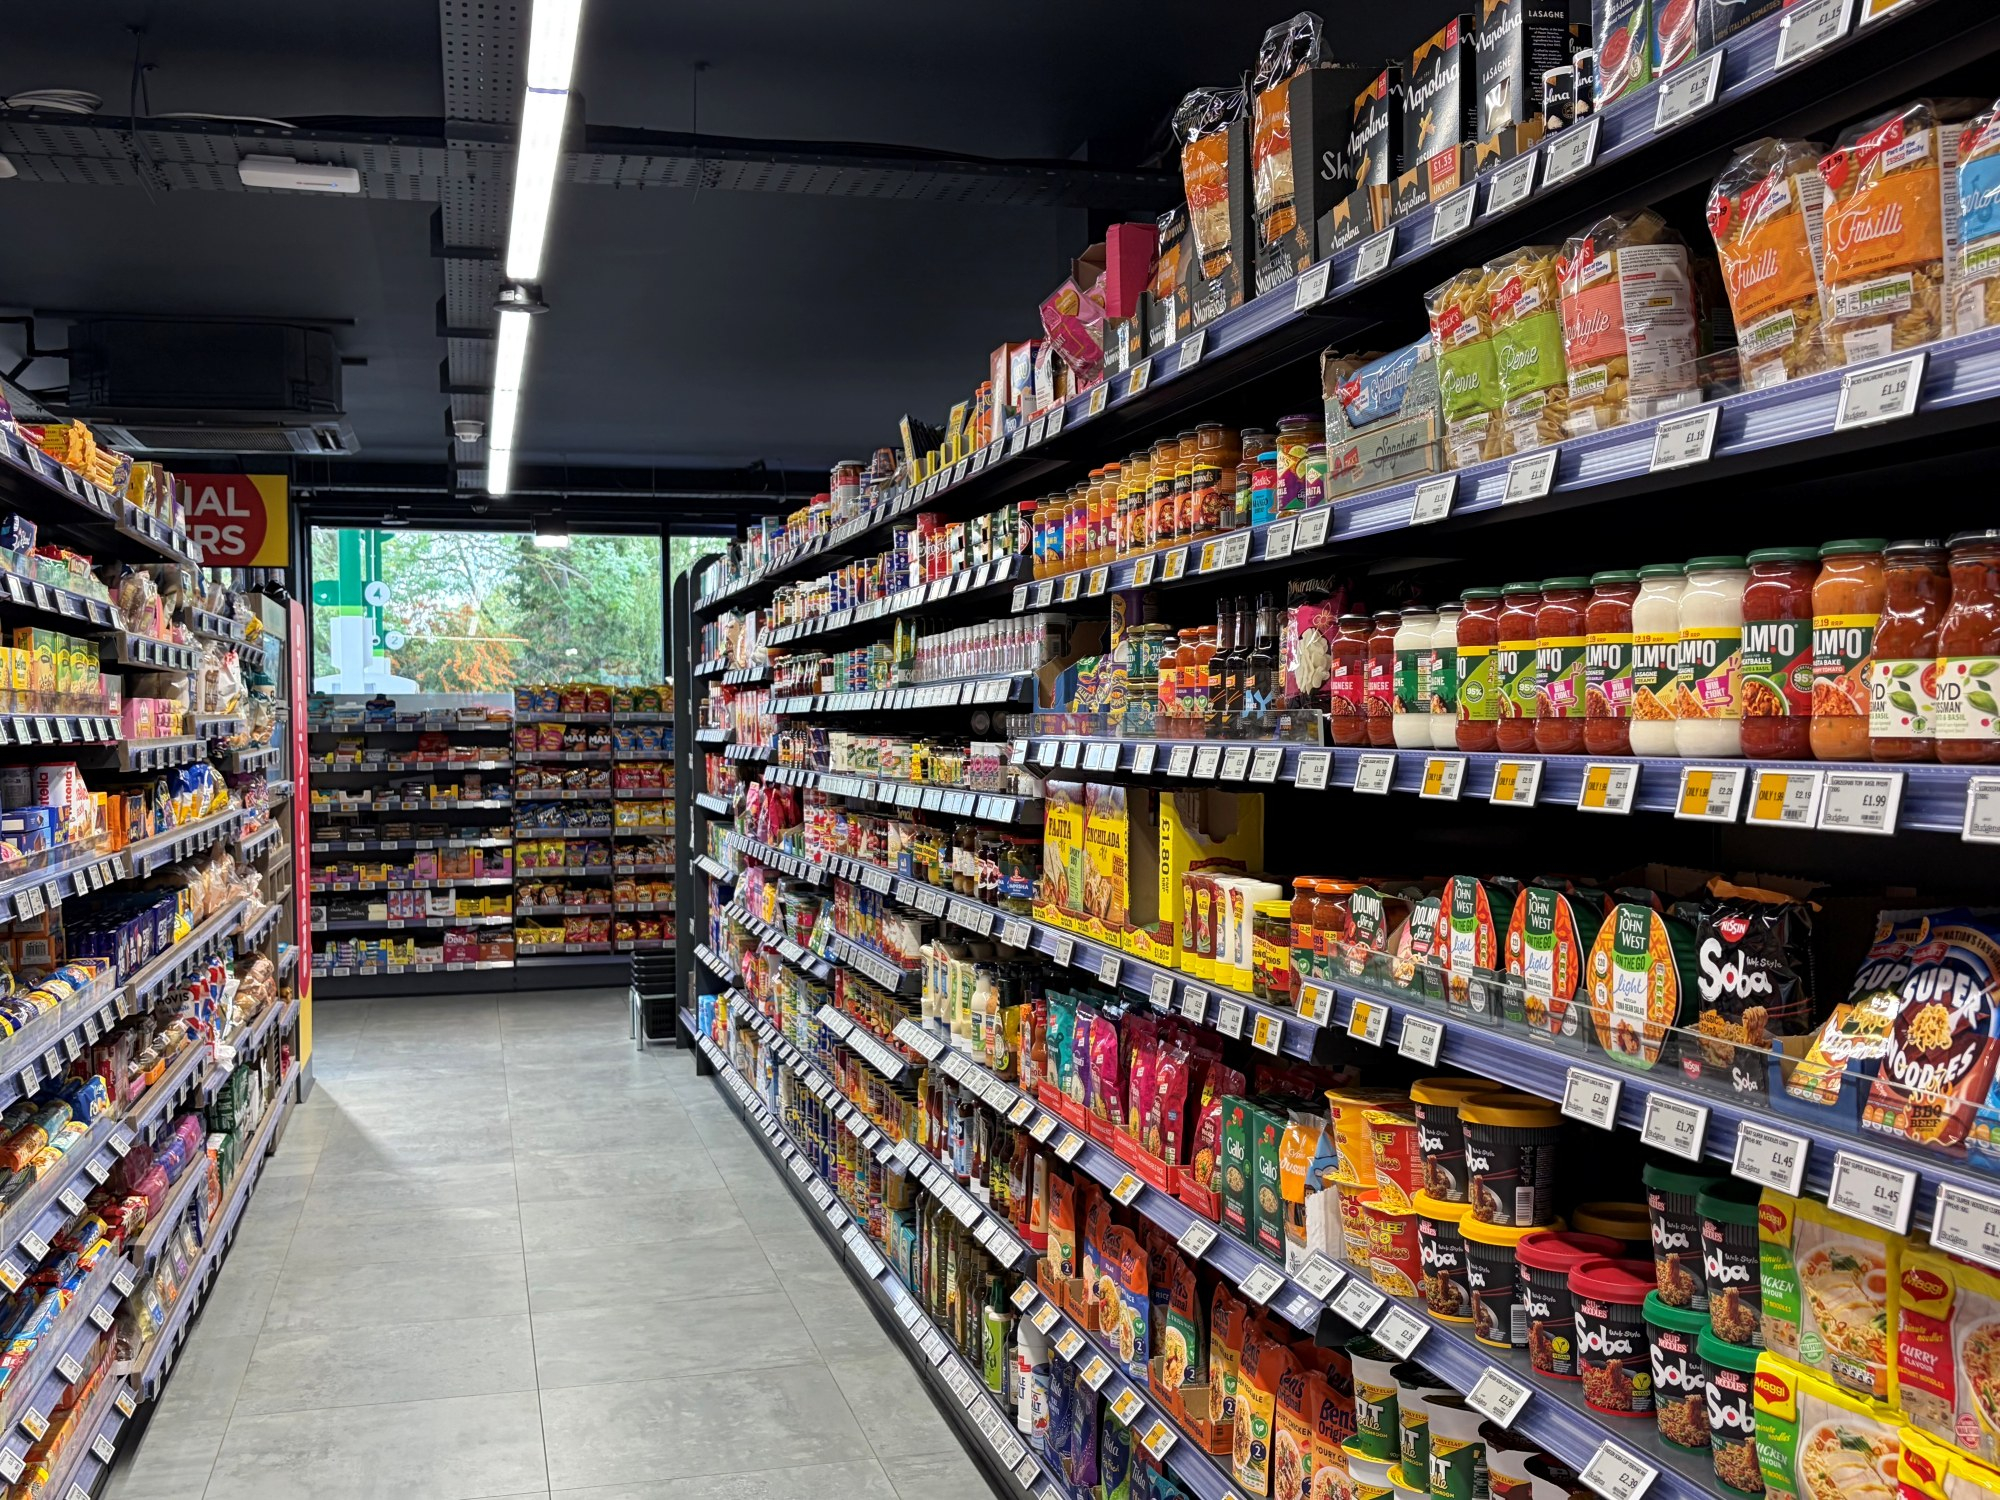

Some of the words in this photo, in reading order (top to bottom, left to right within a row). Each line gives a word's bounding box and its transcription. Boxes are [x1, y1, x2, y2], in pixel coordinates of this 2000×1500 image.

[1528, 9, 1564, 19] LASAGNE
[1729, 14, 1752, 36] ITALIAN
[1751, 1, 1782, 21] TOMATOES
[1818, 6, 1842, 27] £1.15
[1476, 7, 1523, 53] Napolina
[1482, 57, 1512, 85] LASAGNE
[1402, 57, 1459, 113] Napolina
[1690, 76, 1709, 93] £1.39
[1347, 107, 1389, 157] Napolina
[1886, 148, 1899, 158] Part
[1899, 145, 1906, 153] of
[1905, 139, 1916, 150] the
[1905, 142, 1925, 160] family
[1433, 154, 1453, 172] £1.35
[1513, 171, 1528, 186] £2.09
[1394, 189, 1427, 216] Napolina
[1837, 202, 1903, 252] Fusilli
[1331, 222, 1361, 250] Napolina
[1729, 248, 1778, 303] Fusilli
[1440, 311, 1460, 332] JACK'S
[1500, 343, 1539, 381] Penne
[1371, 365, 1410, 403] Spaghetti
[1442, 368, 1480, 394] Penne
[1881, 380, 1906, 397] £1.19
[1686, 429, 1705, 443] £1.19
[1374, 432, 1419, 470] Spaghetti
[1530, 468, 1545, 481] £1.19
[373, 587, 382, 600] 4
[389, 636, 398, 646] 2
[1466, 687, 1483, 696] 95%
[1518, 683, 1537, 692] 95%
[1554, 683, 1566, 692] WIN
[1612, 682, 1624, 690] WIN
[1705, 681, 1720, 690] WIN
[564, 734, 587, 744] MAX
[588, 734, 611, 745] MAX
[1588, 781, 1600, 792] ONLY
[1686, 787, 1700, 798] ONLY
[1718, 787, 1733, 795] £2.29
[1795, 790, 1811, 799] £2.19
[1759, 790, 1773, 801] ONLY
[1774, 790, 1784, 801] 1.99
[1862, 795, 1887, 807] £1.99
[1048, 818, 1072, 840] FAJITA
[1086, 827, 1120, 849] ENCHILADA
[1161, 818, 1171, 876] £1.80
[1453, 885, 1472, 900] JOHN
[1456, 900, 1474, 914] WEST
[1528, 898, 1550, 915] JOHN
[1531, 914, 1553, 931] WEST
[1618, 917, 1644, 935] JOHN
[1721, 917, 1747, 935] NISSIN
[1525, 934, 1535, 946] ON
[1534, 935, 1545, 948] THE
[1544, 936, 1553, 950] GO
[1621, 932, 1647, 951] WEST
[1154, 947, 1166, 960] £1.80
[1525, 953, 1553, 973] light
[1615, 954, 1625, 968] ON
[1624, 955, 1636, 969] THE
[1635, 957, 1647, 972] GO
[1698, 937, 1773, 1003] Soba
[1746, 955, 1759, 968] Wok
[1759, 957, 1783, 970] Style
[1614, 976, 1649, 999] light
[155, 991, 190, 1008] HOVIS
[1898, 967, 1982, 1030] SUPER
[1683, 1061, 1701, 1074] NISSIN
[1886, 1026, 1977, 1092] NOODLES
[1731, 1066, 1759, 1093] Soba
[1911, 1103, 1942, 1119] BBQ
[1676, 1120, 1695, 1135] £1.79
[1910, 1118, 1941, 1128] BEEF
[1226, 1138, 1244, 1161] Gallo
[1258, 1154, 1277, 1182] Gallo
[1772, 1152, 1794, 1168] £1.45
[1874, 1185, 1900, 1204] £1.45
[1759, 1209, 1783, 1227] Maggi
[1666, 1222, 1680, 1232] Wok
[1680, 1224, 1698, 1232] Style
[1725, 1252, 1738, 1263] Wok
[1740, 1255, 1758, 1264] Style
[1903, 1276, 1943, 1297] Maggi
[1580, 1305, 1609, 1320] NOODLES
[1401, 1327, 1415, 1343] £2.39
[1574, 1311, 1633, 1356] Soba
[1608, 1328, 1623, 1338] Wok
[1623, 1330, 1641, 1339] Style
[1663, 1333, 1681, 1342] CUP
[1916, 1331, 1945, 1344] noodles
[1658, 1337, 1688, 1354] NOODLES
[1552, 1353, 1571, 1361] VEGAN
[1900, 1344, 1939, 1367] CURRY
[1650, 1343, 1705, 1391] Soba
[1904, 1356, 1935, 1374] FLAVOUR
[1715, 1376, 1748, 1393] NOODLES
[1720, 1370, 1740, 1382] CUP
[1755, 1378, 1785, 1399] Maggi
[1278, 1389, 1302, 1414] Original
[1498, 1394, 1515, 1409] £2.39
[1319, 1397, 1357, 1432] Ben's
[1287, 1417, 1312, 1437] CHICKEN
[1768, 1431, 1791, 1442] noodles
[1255, 1445, 1261, 1457] 2
[1619, 1473, 1639, 1490] £2.39
